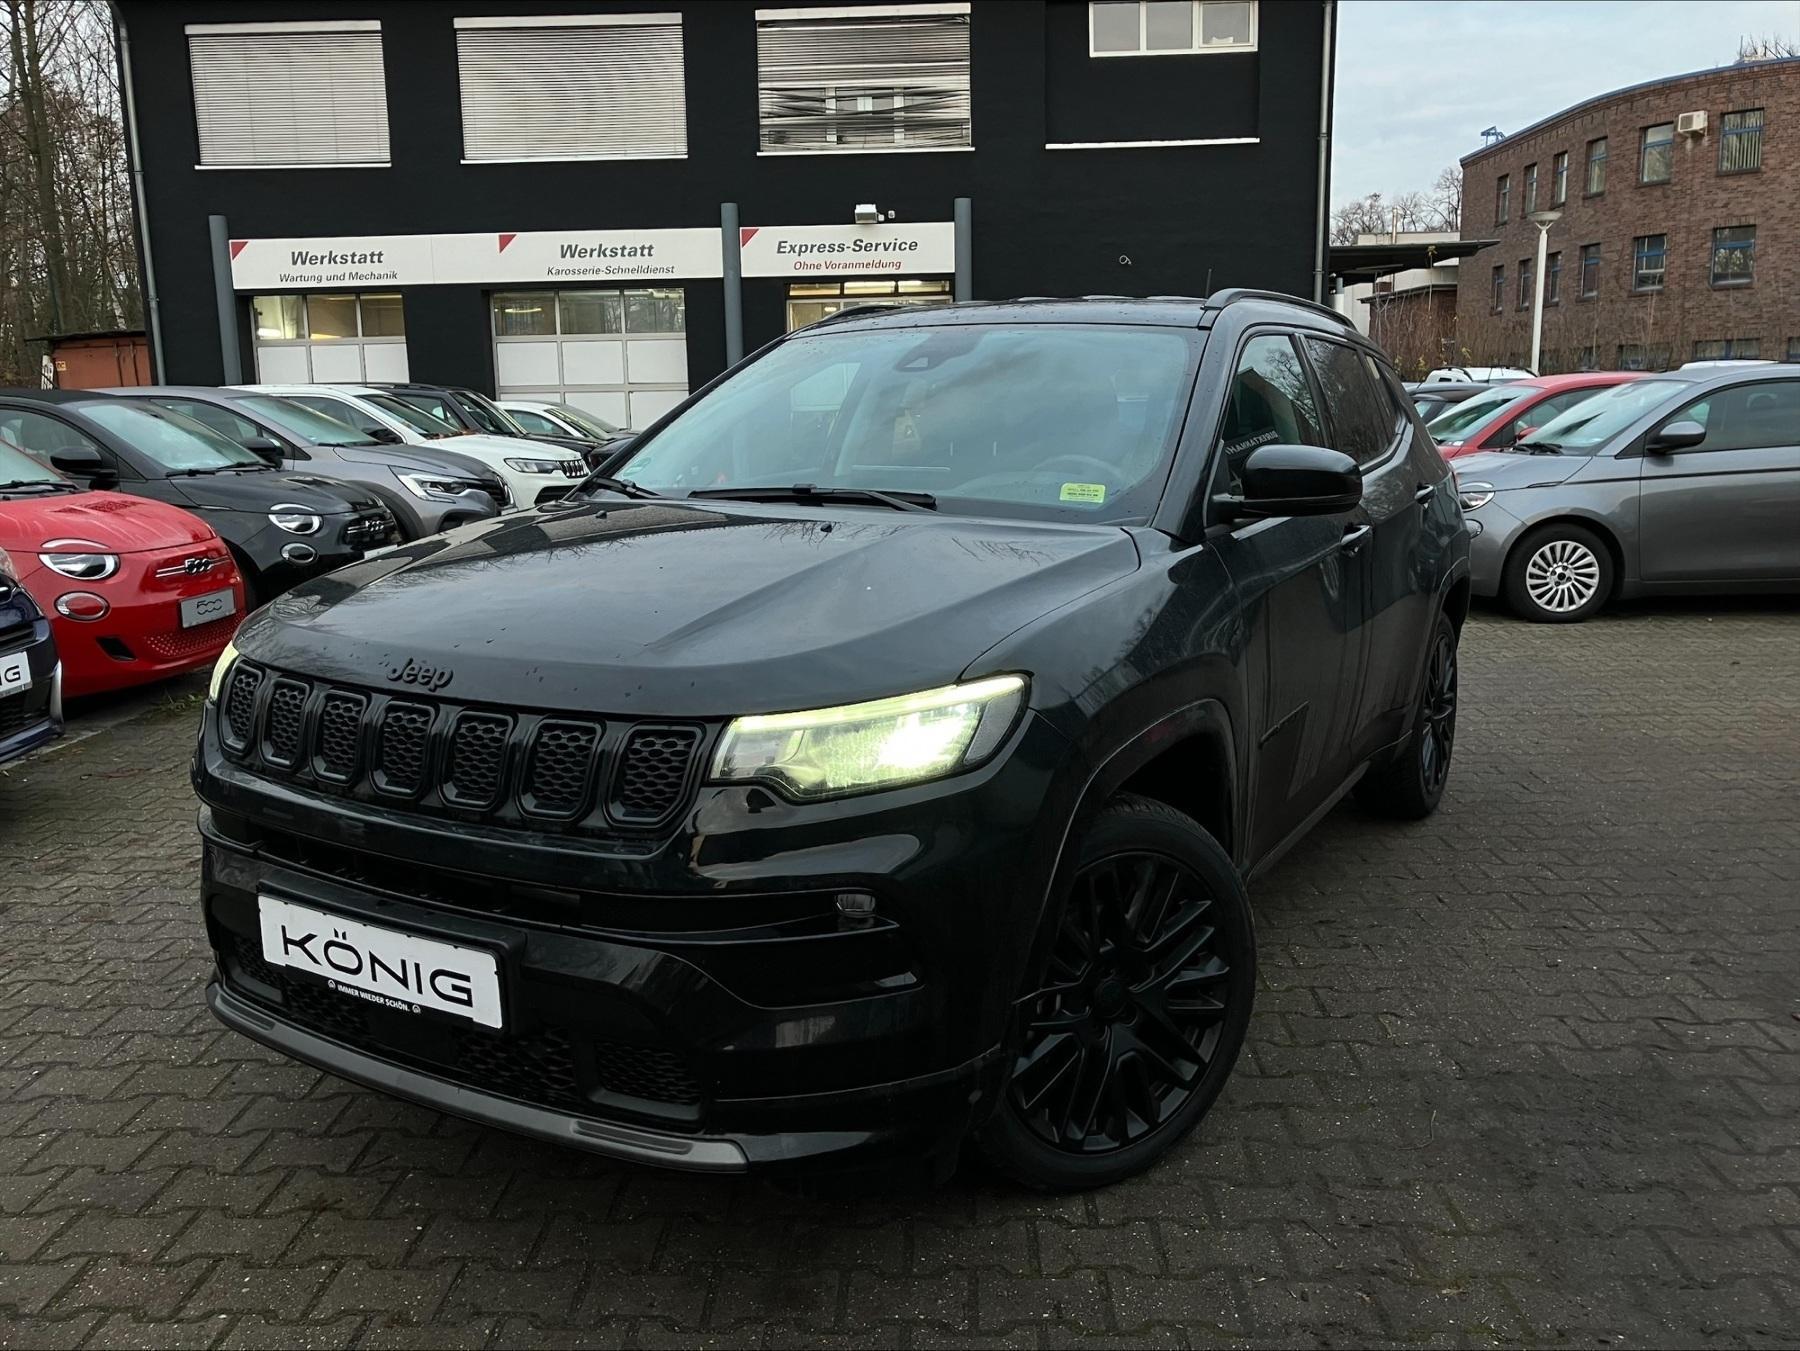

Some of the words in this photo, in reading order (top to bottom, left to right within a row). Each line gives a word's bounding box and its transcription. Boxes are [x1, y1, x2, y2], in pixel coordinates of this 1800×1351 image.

[560, 243, 654, 258] Werkstatt
[777, 238, 918, 256] Express-Service
[291, 250, 384, 265] Werkstatt
[794, 261, 822, 271] Ohne
[824, 259, 902, 270] Voranmeldung
[279, 273, 323, 284] Wartung
[326, 272, 346, 282] und
[348, 270, 398, 281] Mechanik
[547, 265, 675, 276] Karosserie-Schnelldienst
[196, 598, 222, 615] 500
[386, 657, 454, 692] Jeep
[281, 924, 473, 1008] KÖNIG
[337, 984, 360, 996] IMMER
[385, 998, 411, 1012] SCHÖN.
